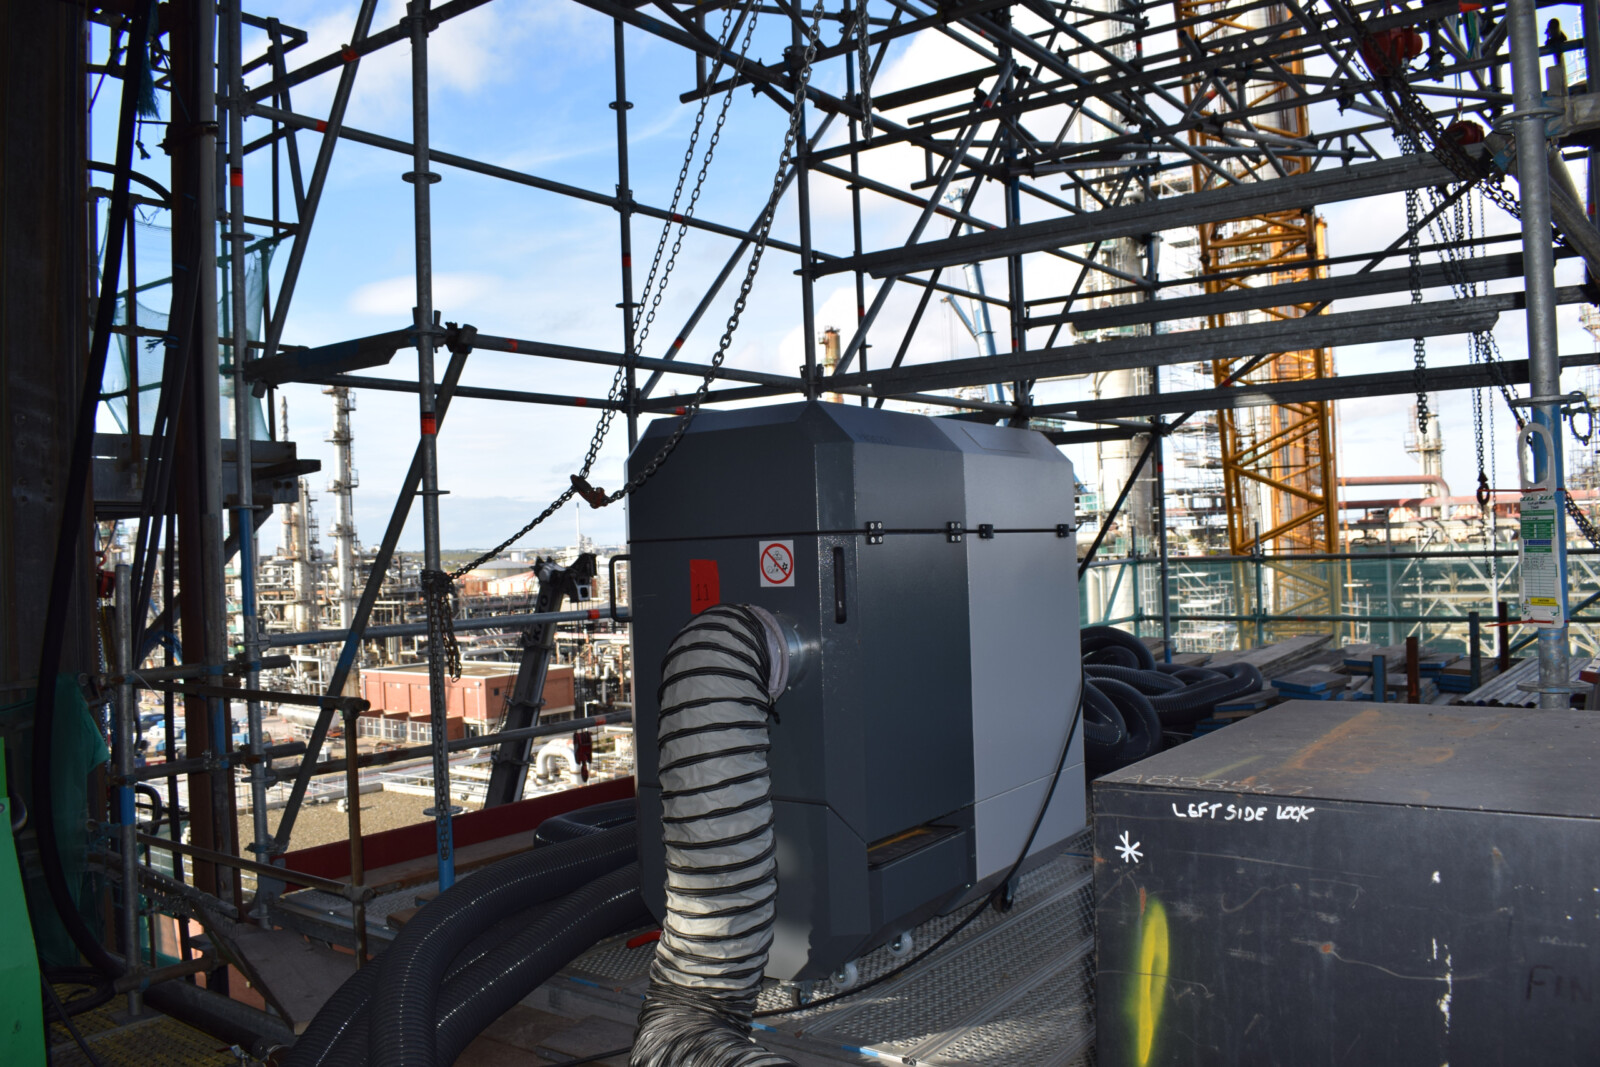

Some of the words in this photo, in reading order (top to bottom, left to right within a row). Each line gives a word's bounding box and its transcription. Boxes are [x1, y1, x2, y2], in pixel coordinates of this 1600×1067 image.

[532, 595, 548, 641] KTO
[1172, 801, 1222, 819] LEFT
[1224, 804, 1267, 821] SIDE
